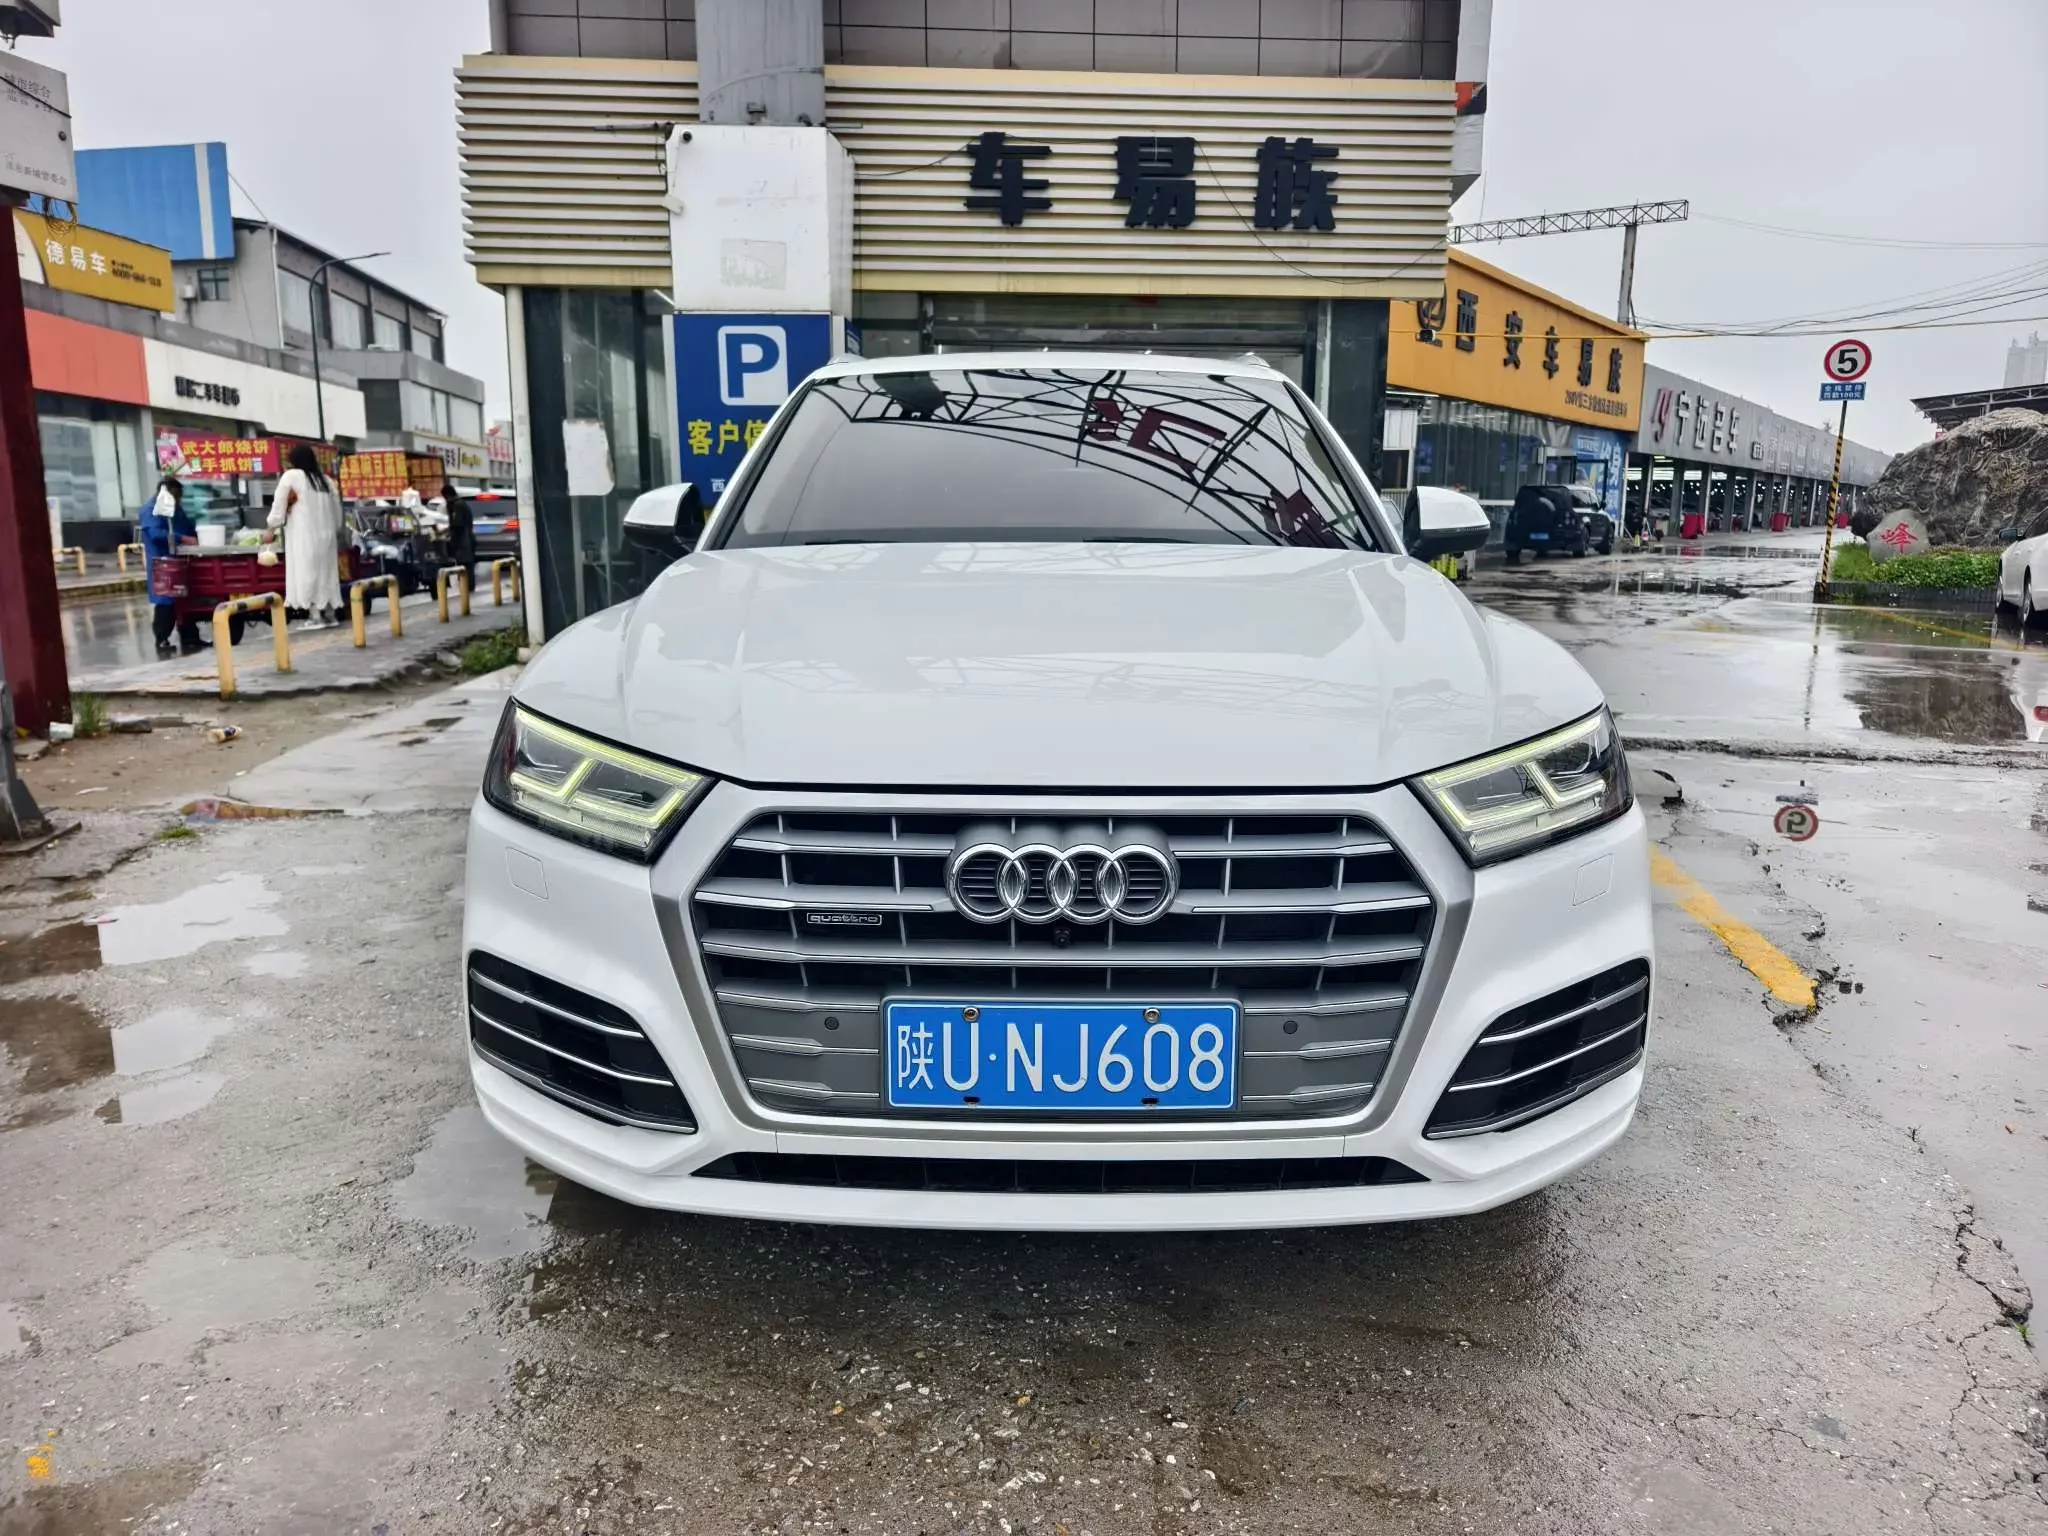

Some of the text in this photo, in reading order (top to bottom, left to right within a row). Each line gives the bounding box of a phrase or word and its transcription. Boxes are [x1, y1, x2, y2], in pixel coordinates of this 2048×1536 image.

[964, 131, 1339, 230] 车易族
[44, 239, 107, 276] 德易车
[725, 333, 780, 399] P
[1455, 288, 1624, 394] 西安车易族
[1837, 348, 1858, 375] 5
[182, 439, 269, 456] 武大郎烧饼
[810, 914, 879, 925] quattro
[897, 1021, 1224, 1093] 陕U·NJ608
